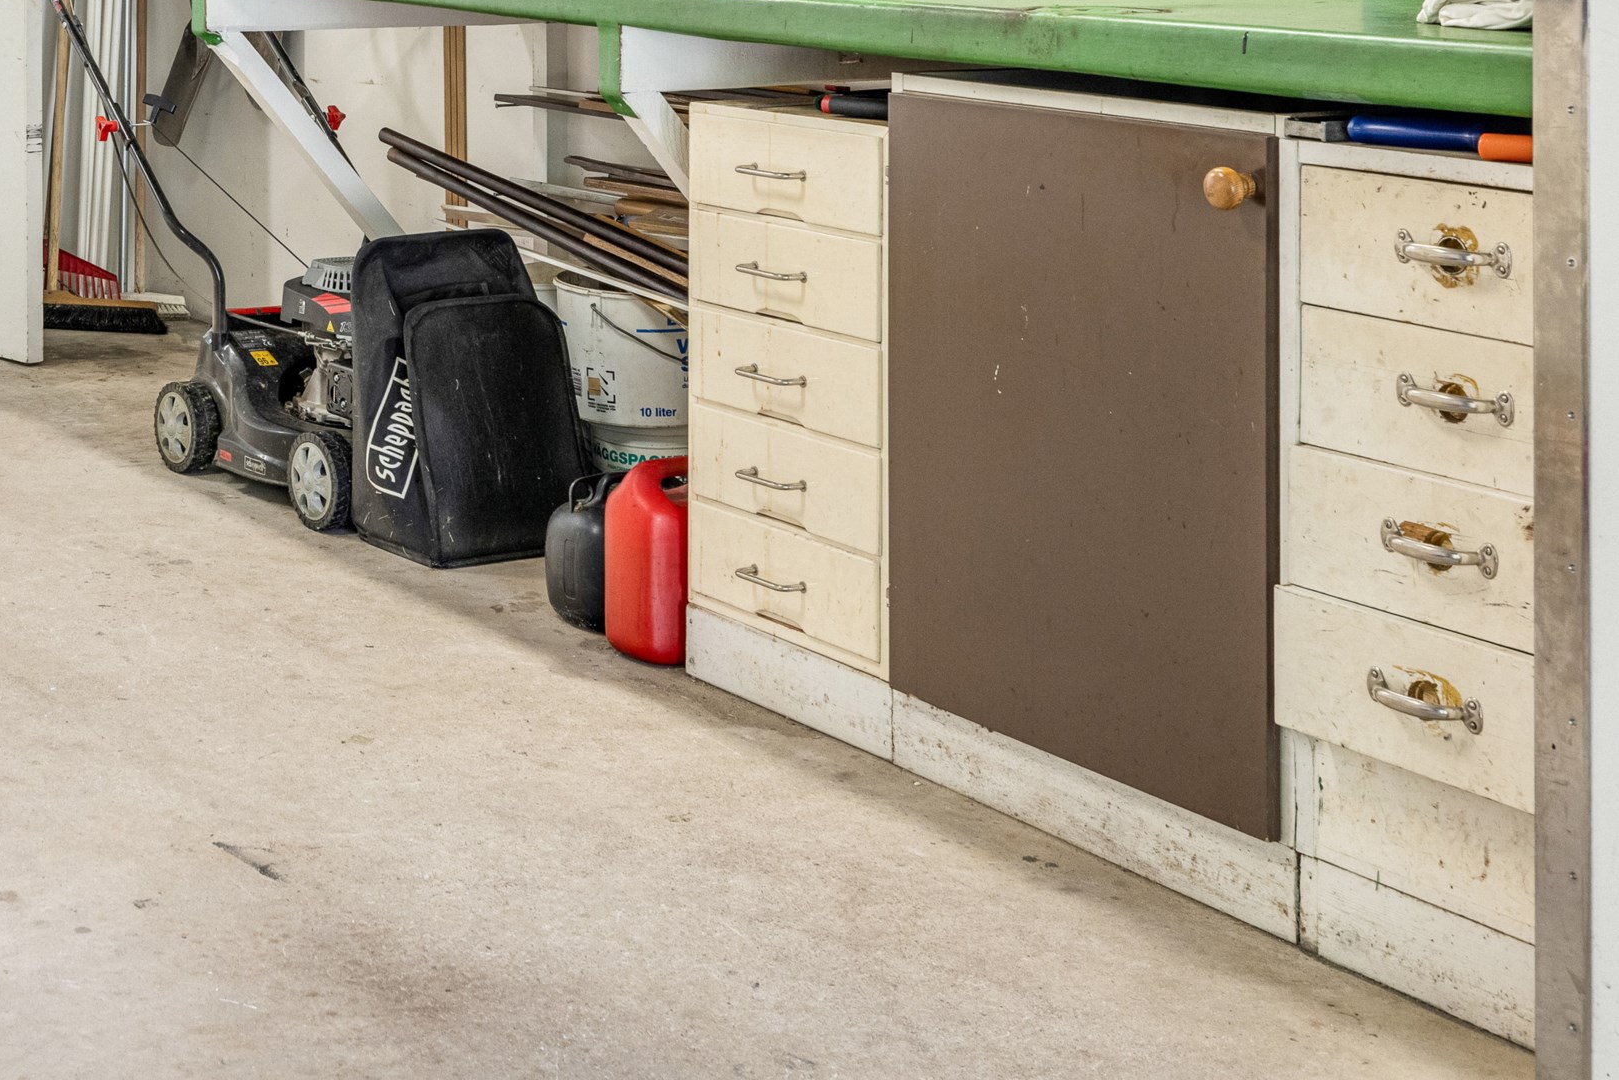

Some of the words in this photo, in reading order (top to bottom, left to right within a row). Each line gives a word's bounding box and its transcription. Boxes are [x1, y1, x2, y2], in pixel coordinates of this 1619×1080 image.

[257, 357, 270, 365] 96
[639, 407, 652, 417] 10
[655, 407, 677, 417] liter
